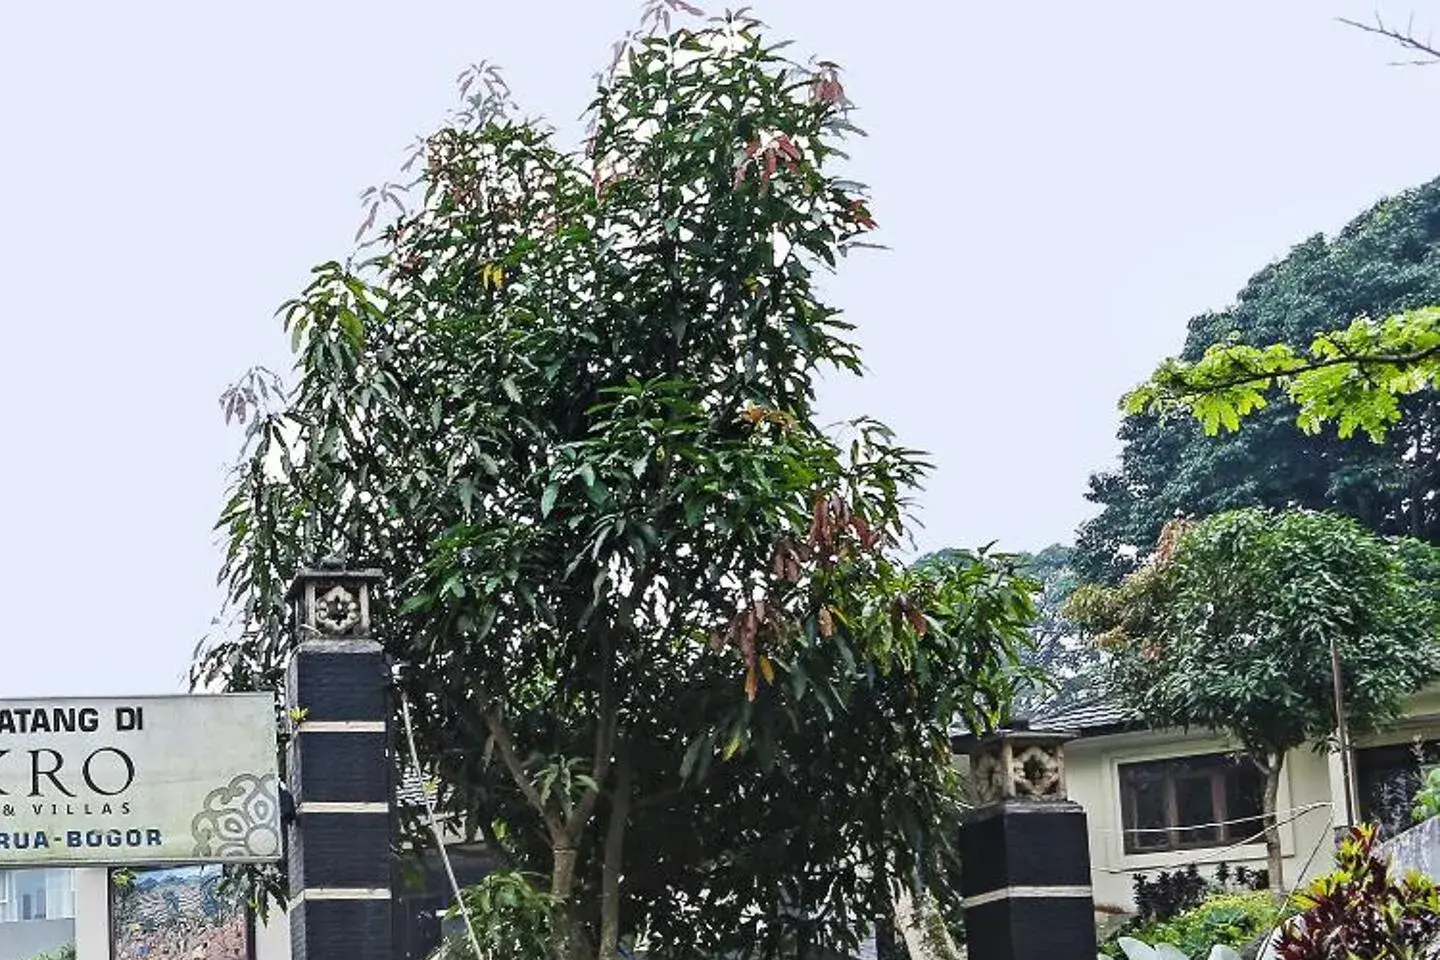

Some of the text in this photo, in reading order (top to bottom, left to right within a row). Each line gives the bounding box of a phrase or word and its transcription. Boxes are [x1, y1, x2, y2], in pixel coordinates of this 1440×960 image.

[115, 706, 144, 732] DI
[3, 803, 15, 817] &
[32, 802, 131, 816] VILLAS
